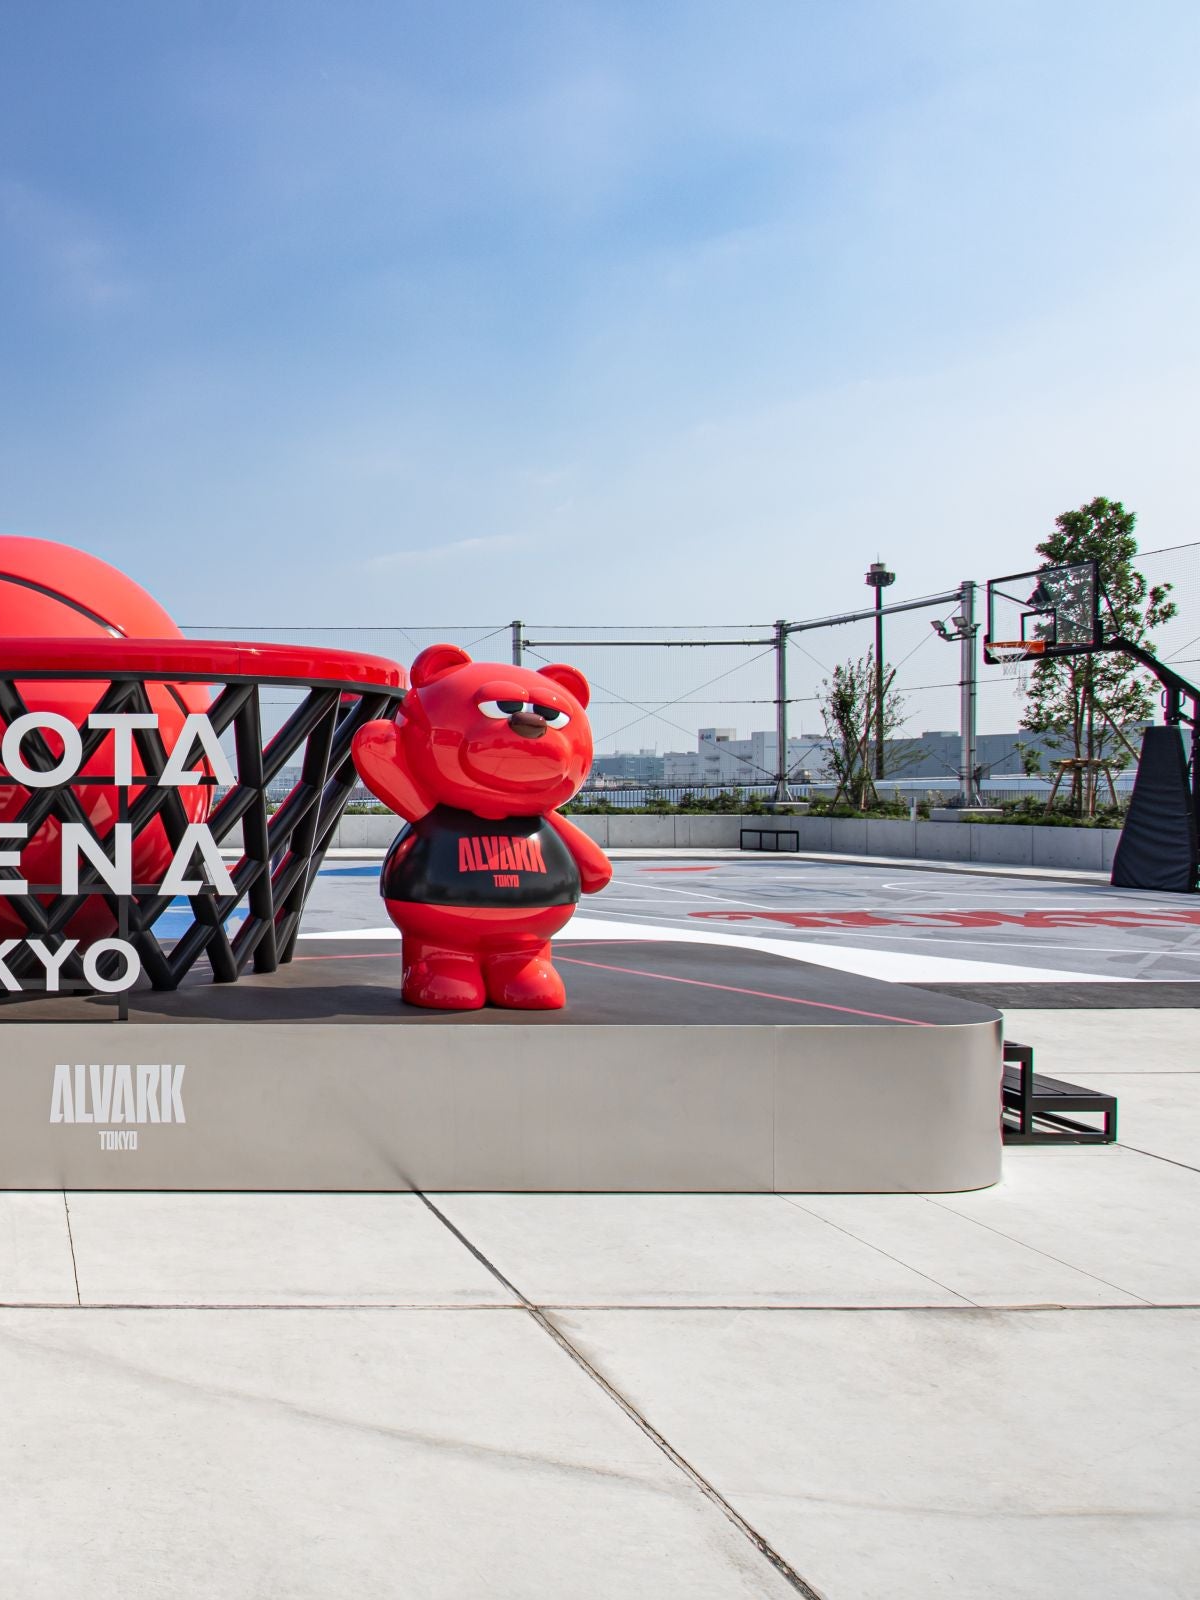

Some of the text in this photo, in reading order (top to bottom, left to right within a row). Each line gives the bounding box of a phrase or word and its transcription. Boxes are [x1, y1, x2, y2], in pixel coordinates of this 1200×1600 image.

[458, 835, 547, 874] ALVARK
[493, 874, 520, 888] TOKYO
[50, 1064, 186, 1124] ALVARK
[98, 1130, 138, 1151] TOKYO
